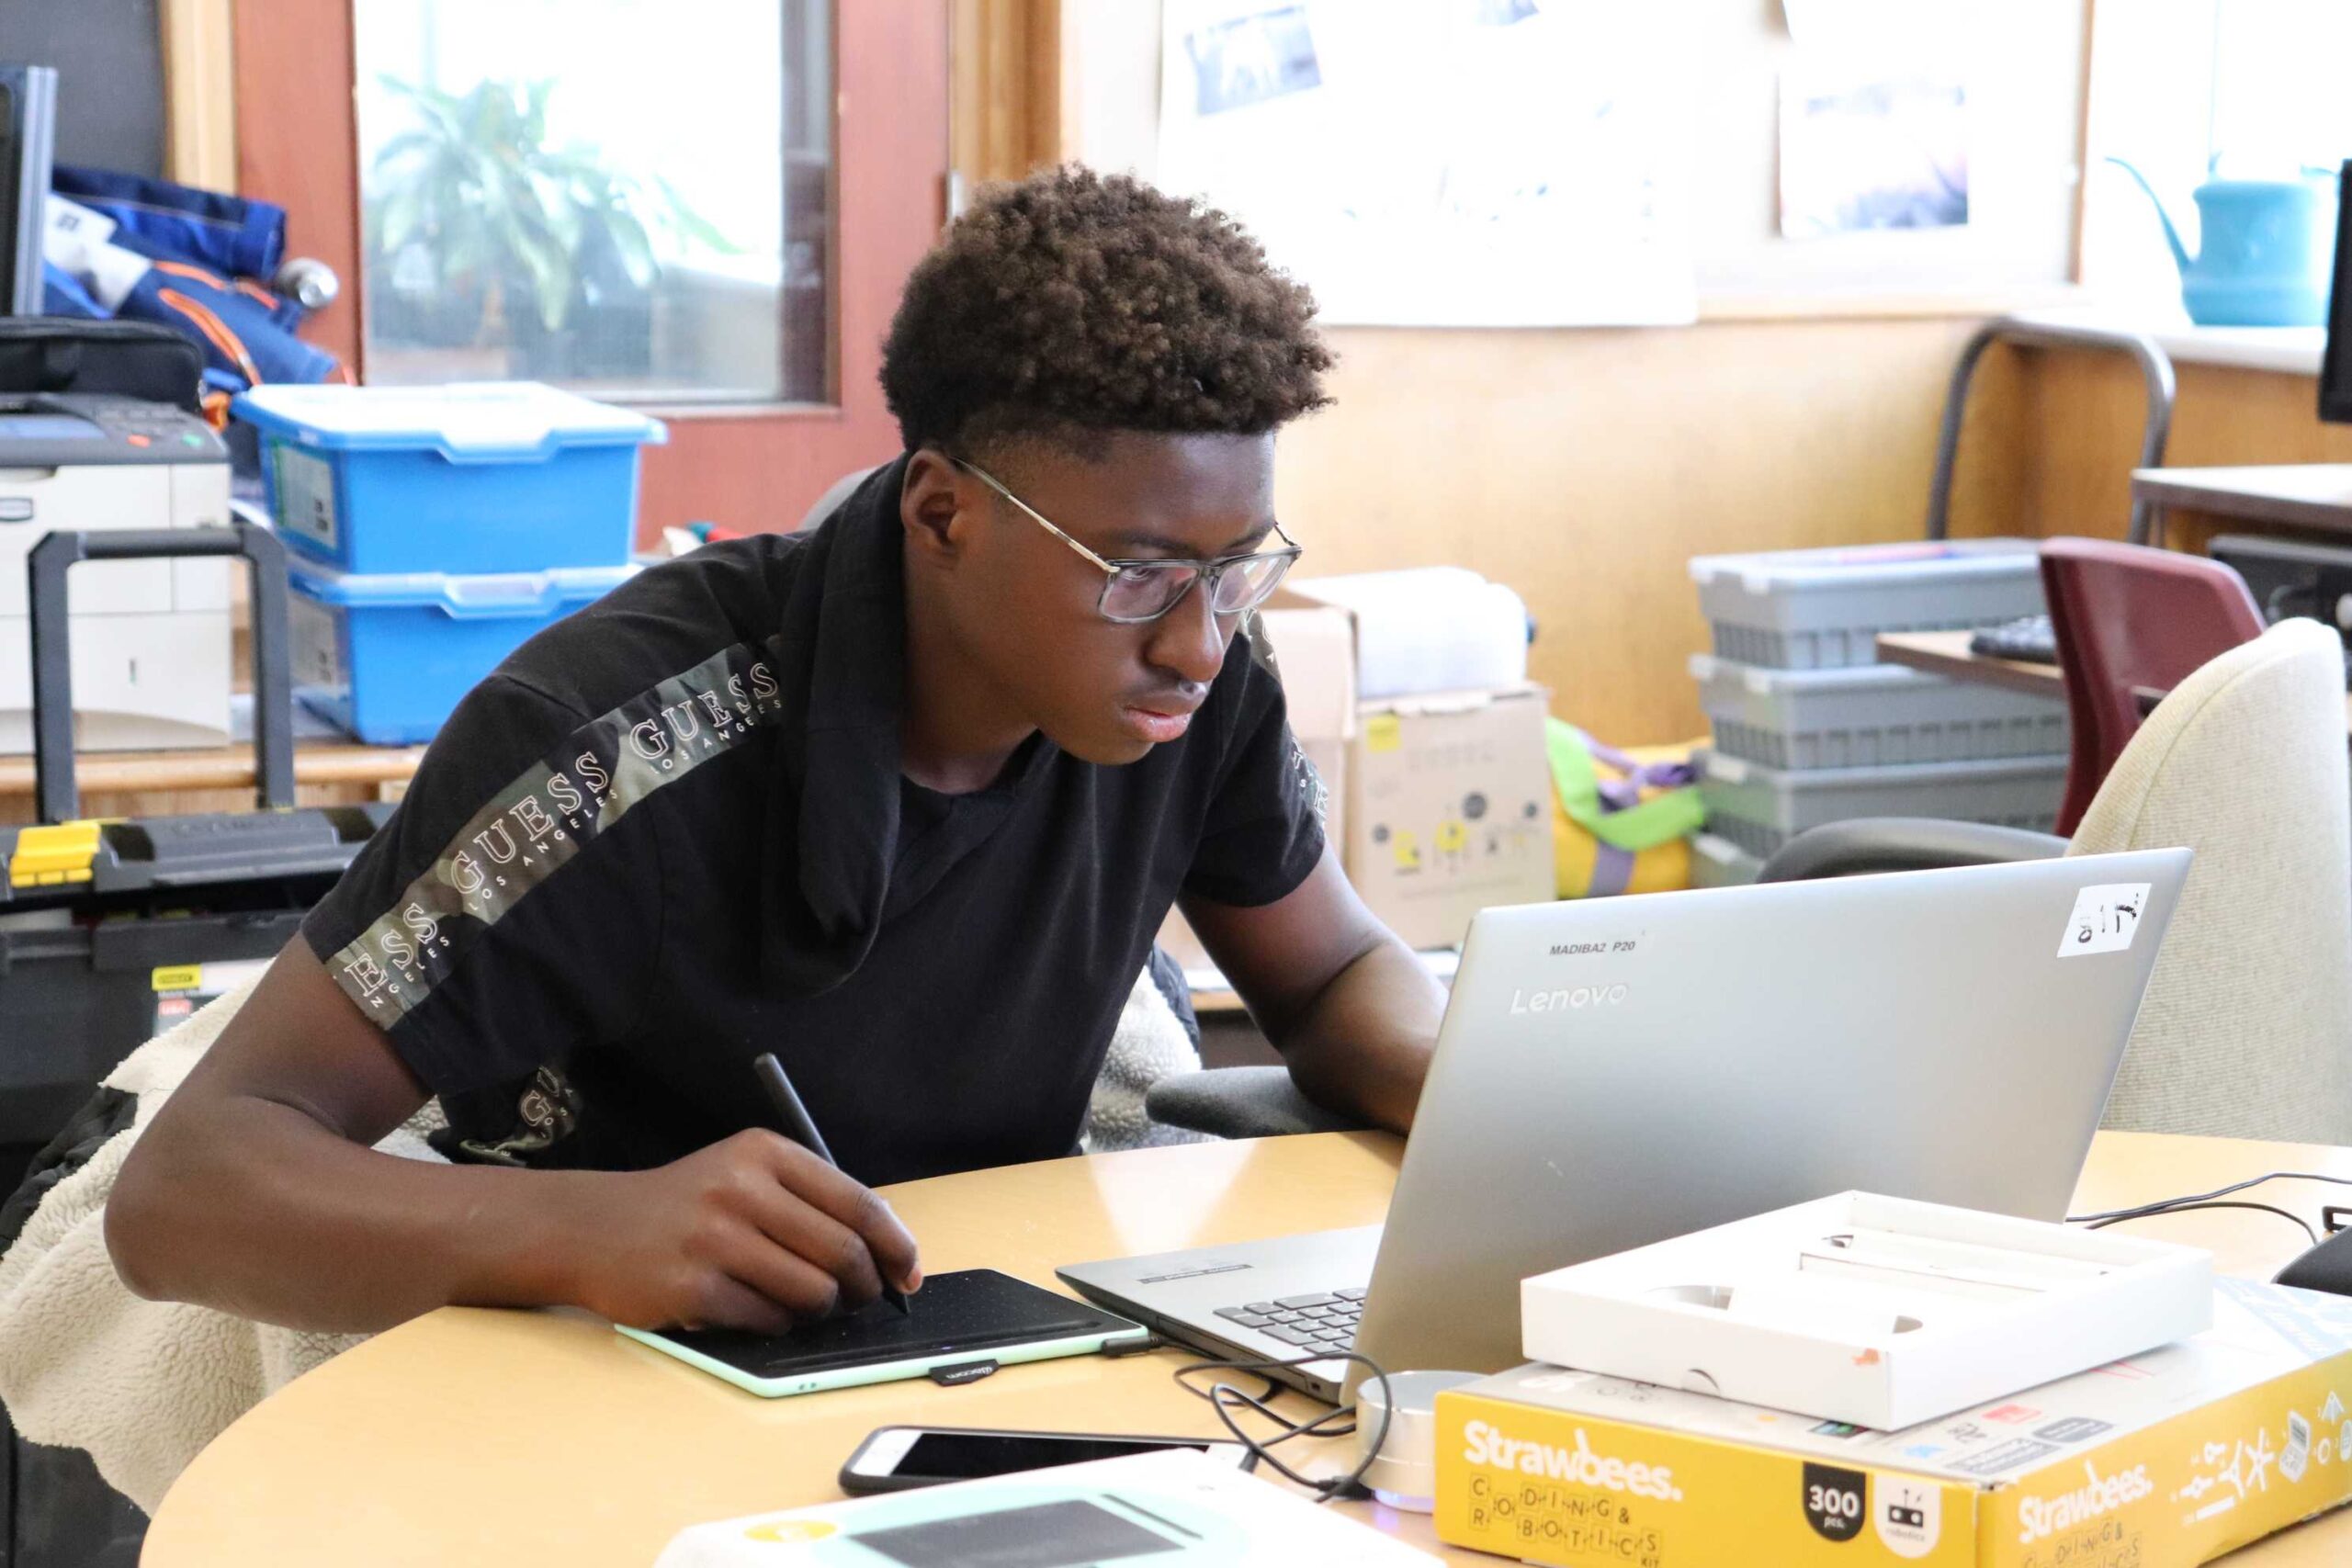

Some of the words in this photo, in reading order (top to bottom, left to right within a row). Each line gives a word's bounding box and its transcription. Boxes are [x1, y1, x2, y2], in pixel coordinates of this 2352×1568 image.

[629, 662, 778, 760] GUESS
[650, 750, 690, 775] LOS
[702, 700, 782, 749] ANGEES
[450, 751, 608, 895] GUESS
[468, 874, 507, 911] LOS
[522, 788, 618, 867] ANGELES
[1612, 941, 1636, 953] P20
[1510, 983, 1628, 1014] Lenovo
[1463, 1419, 1683, 1502] Strawbees.
[1808, 1483, 1860, 1517] 300
